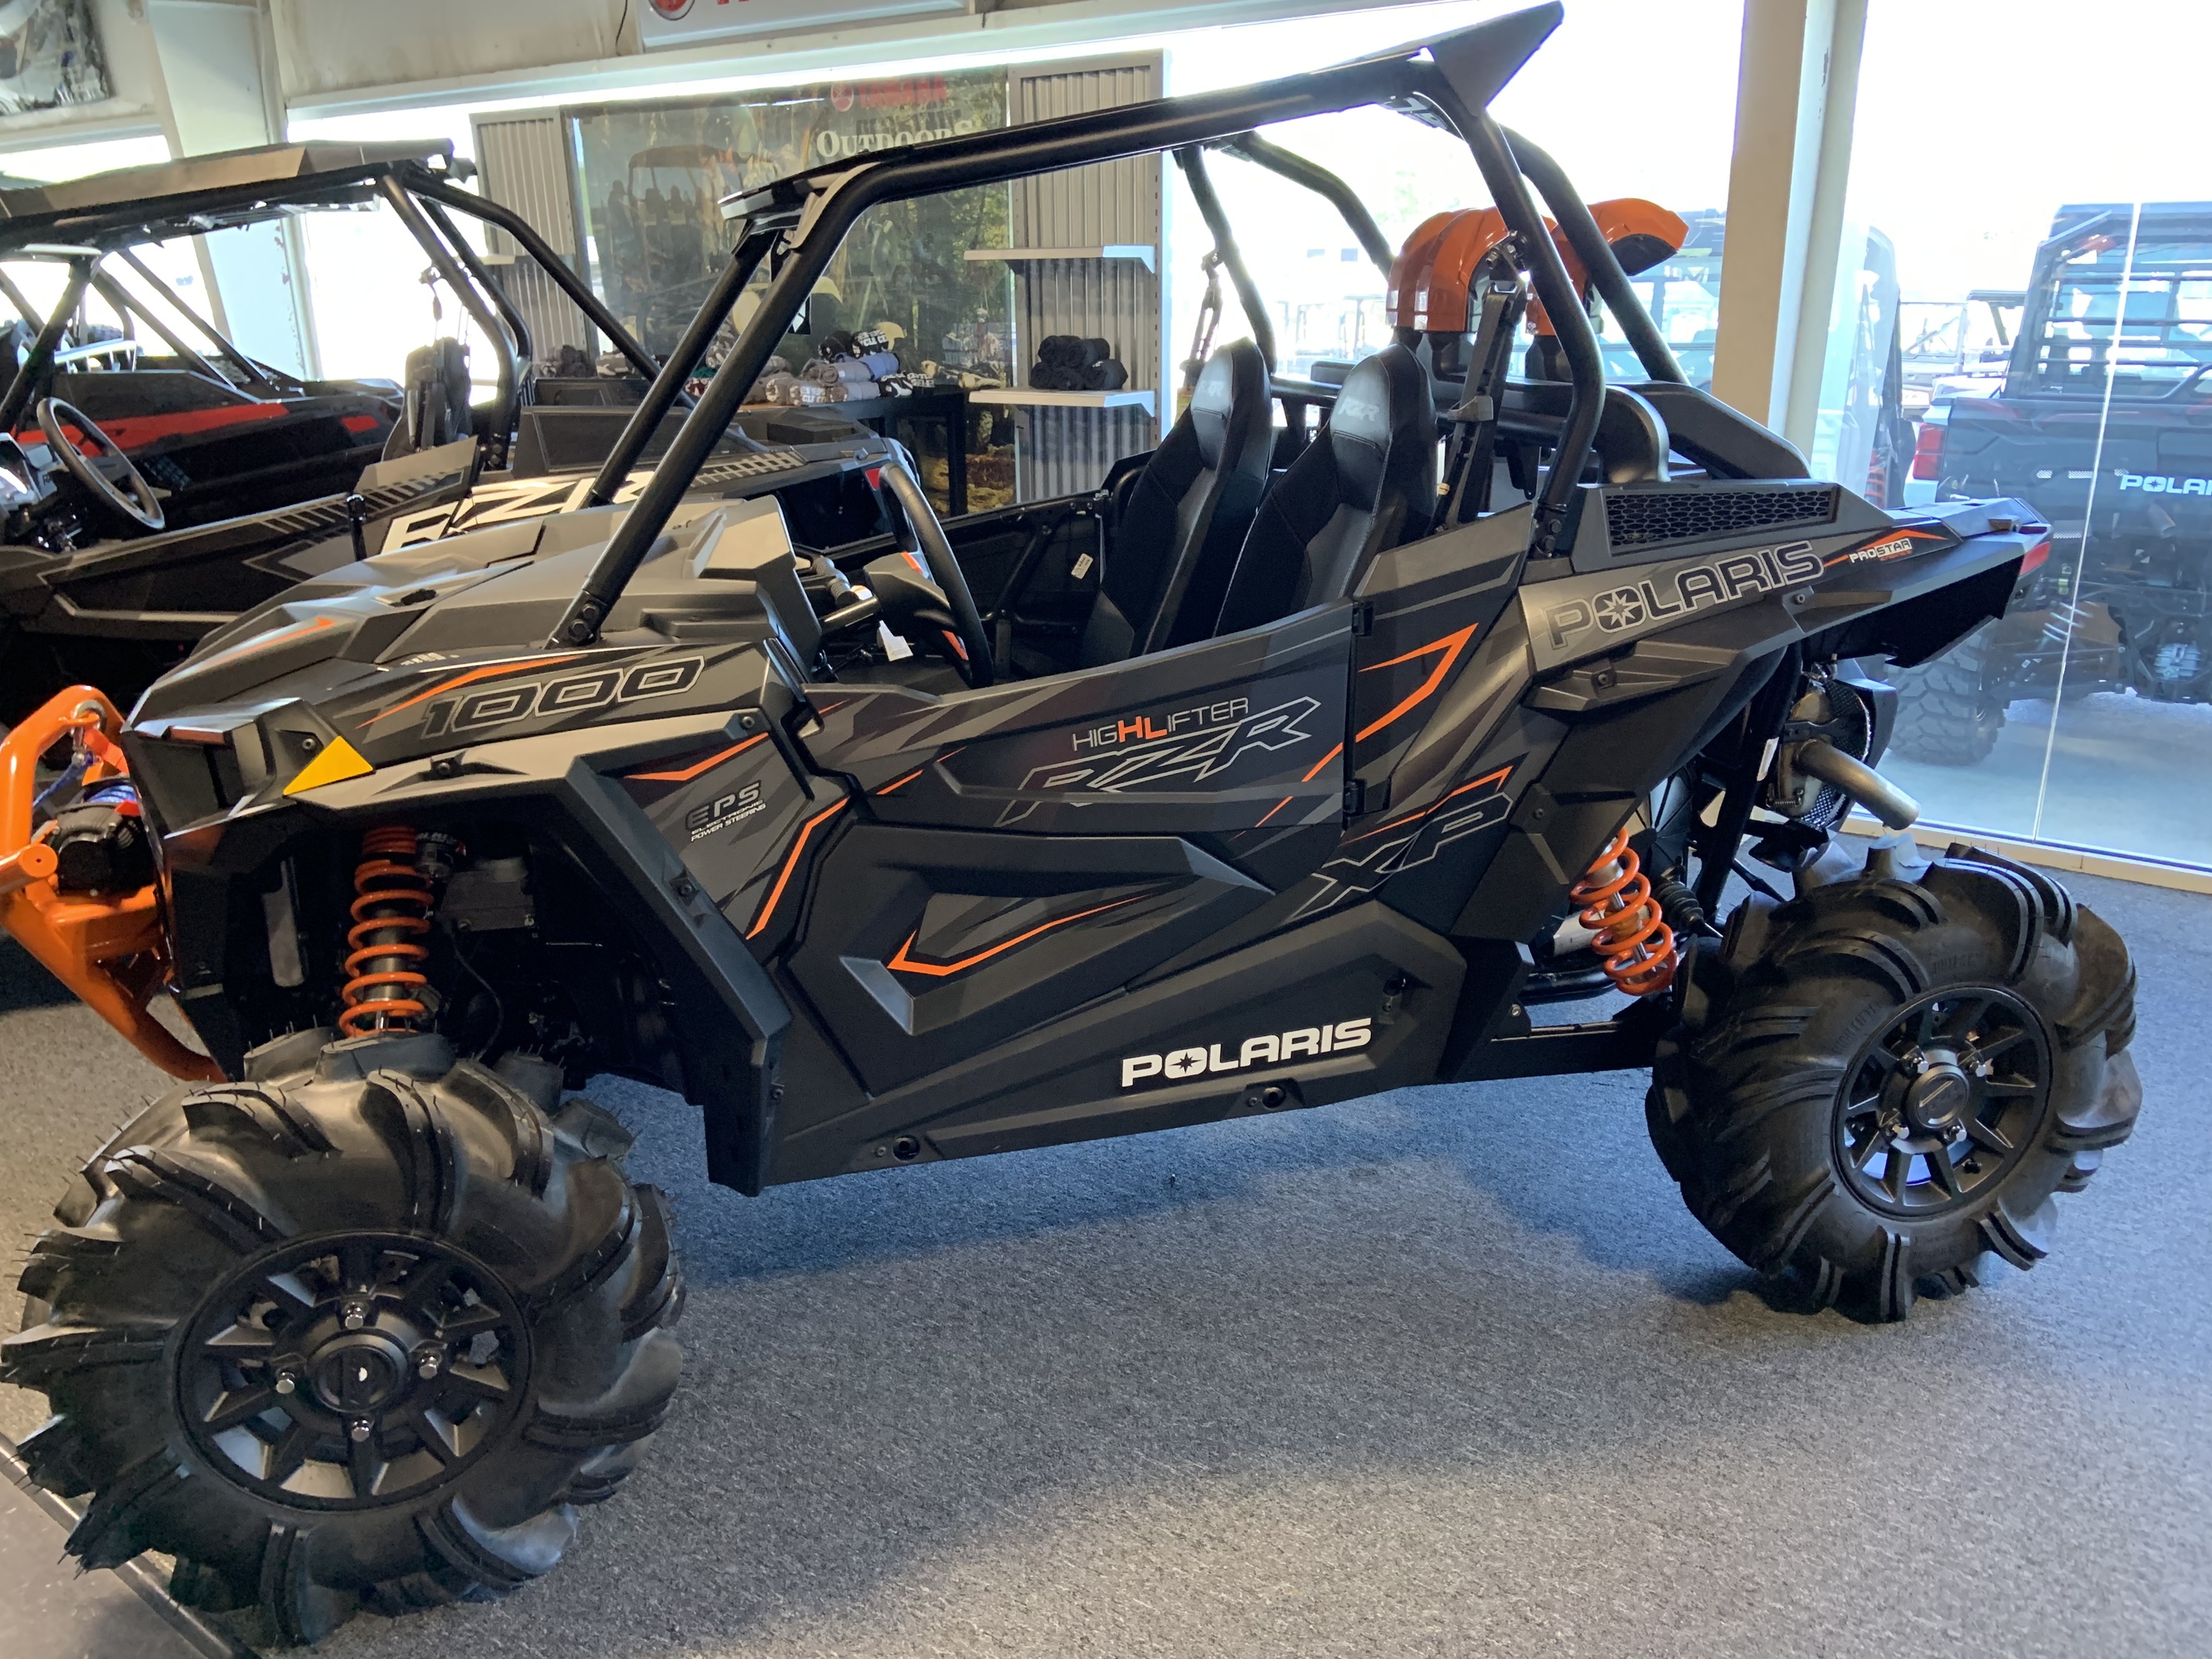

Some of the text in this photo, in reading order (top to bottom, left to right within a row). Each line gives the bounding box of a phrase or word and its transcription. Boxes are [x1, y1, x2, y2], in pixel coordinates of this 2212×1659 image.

[1849, 538, 1913, 563] PROSTAR
[1542, 540, 1825, 650] POLARIS
[421, 654, 705, 740] 1000
[685, 780, 761, 831] EPS
[691, 799, 764, 834] ELECTRONIC
[691, 803, 766, 842] POWER STEERING
[1121, 1017, 1373, 1087] POLARIS
